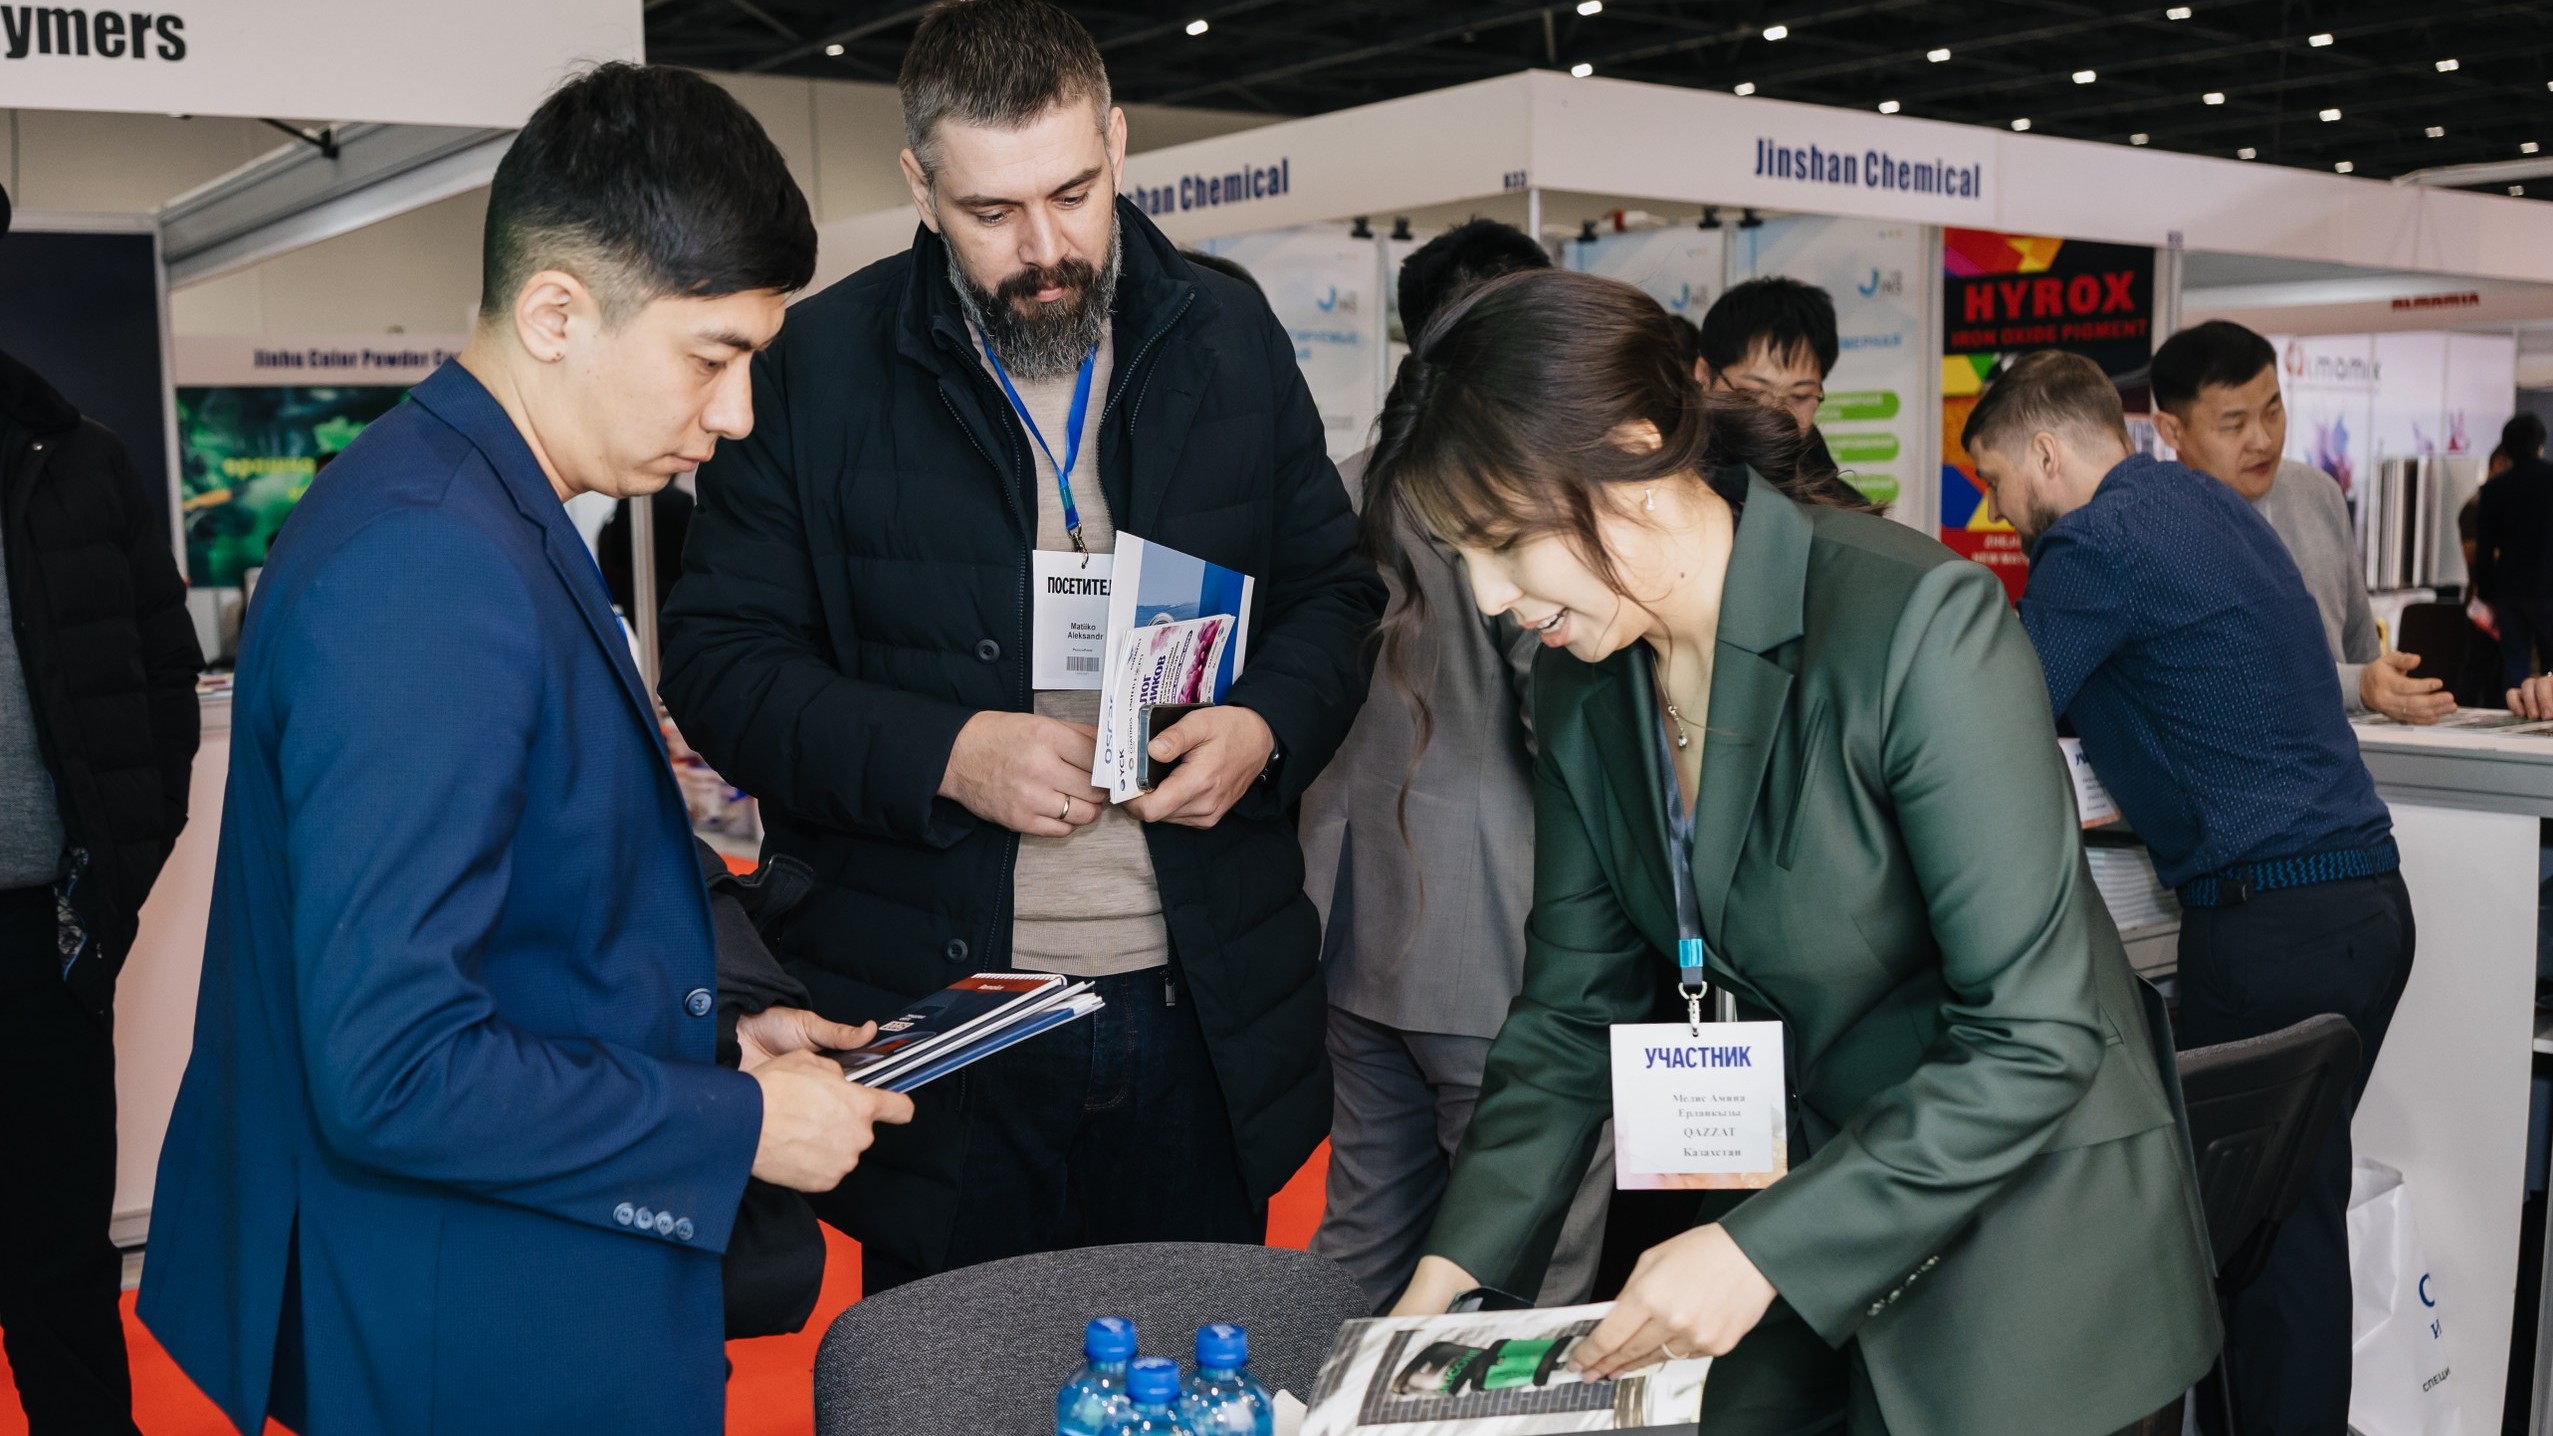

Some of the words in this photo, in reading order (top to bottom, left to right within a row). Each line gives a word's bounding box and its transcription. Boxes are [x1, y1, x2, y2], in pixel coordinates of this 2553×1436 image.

[0, 4, 188, 62] ymers
[1755, 137, 1859, 186] Jinshan
[1864, 150, 1982, 199] Chemical
[1179, 156, 1289, 211] Chemical
[1964, 269, 2135, 324] HYROX
[1951, 330, 1997, 347] IRON
[2001, 325, 2057, 345] OXIDE
[2060, 318, 2148, 341] PIGMENT
[307, 350, 355, 368] Color
[361, 350, 429, 369] Powder
[1067, 631, 1104, 641] Aleksandr
[1644, 1046, 1753, 1069] УЧАСТНИК
[1683, 1127, 1736, 1139] QAZZAT
[1683, 1147, 1742, 1157] Казахстан
